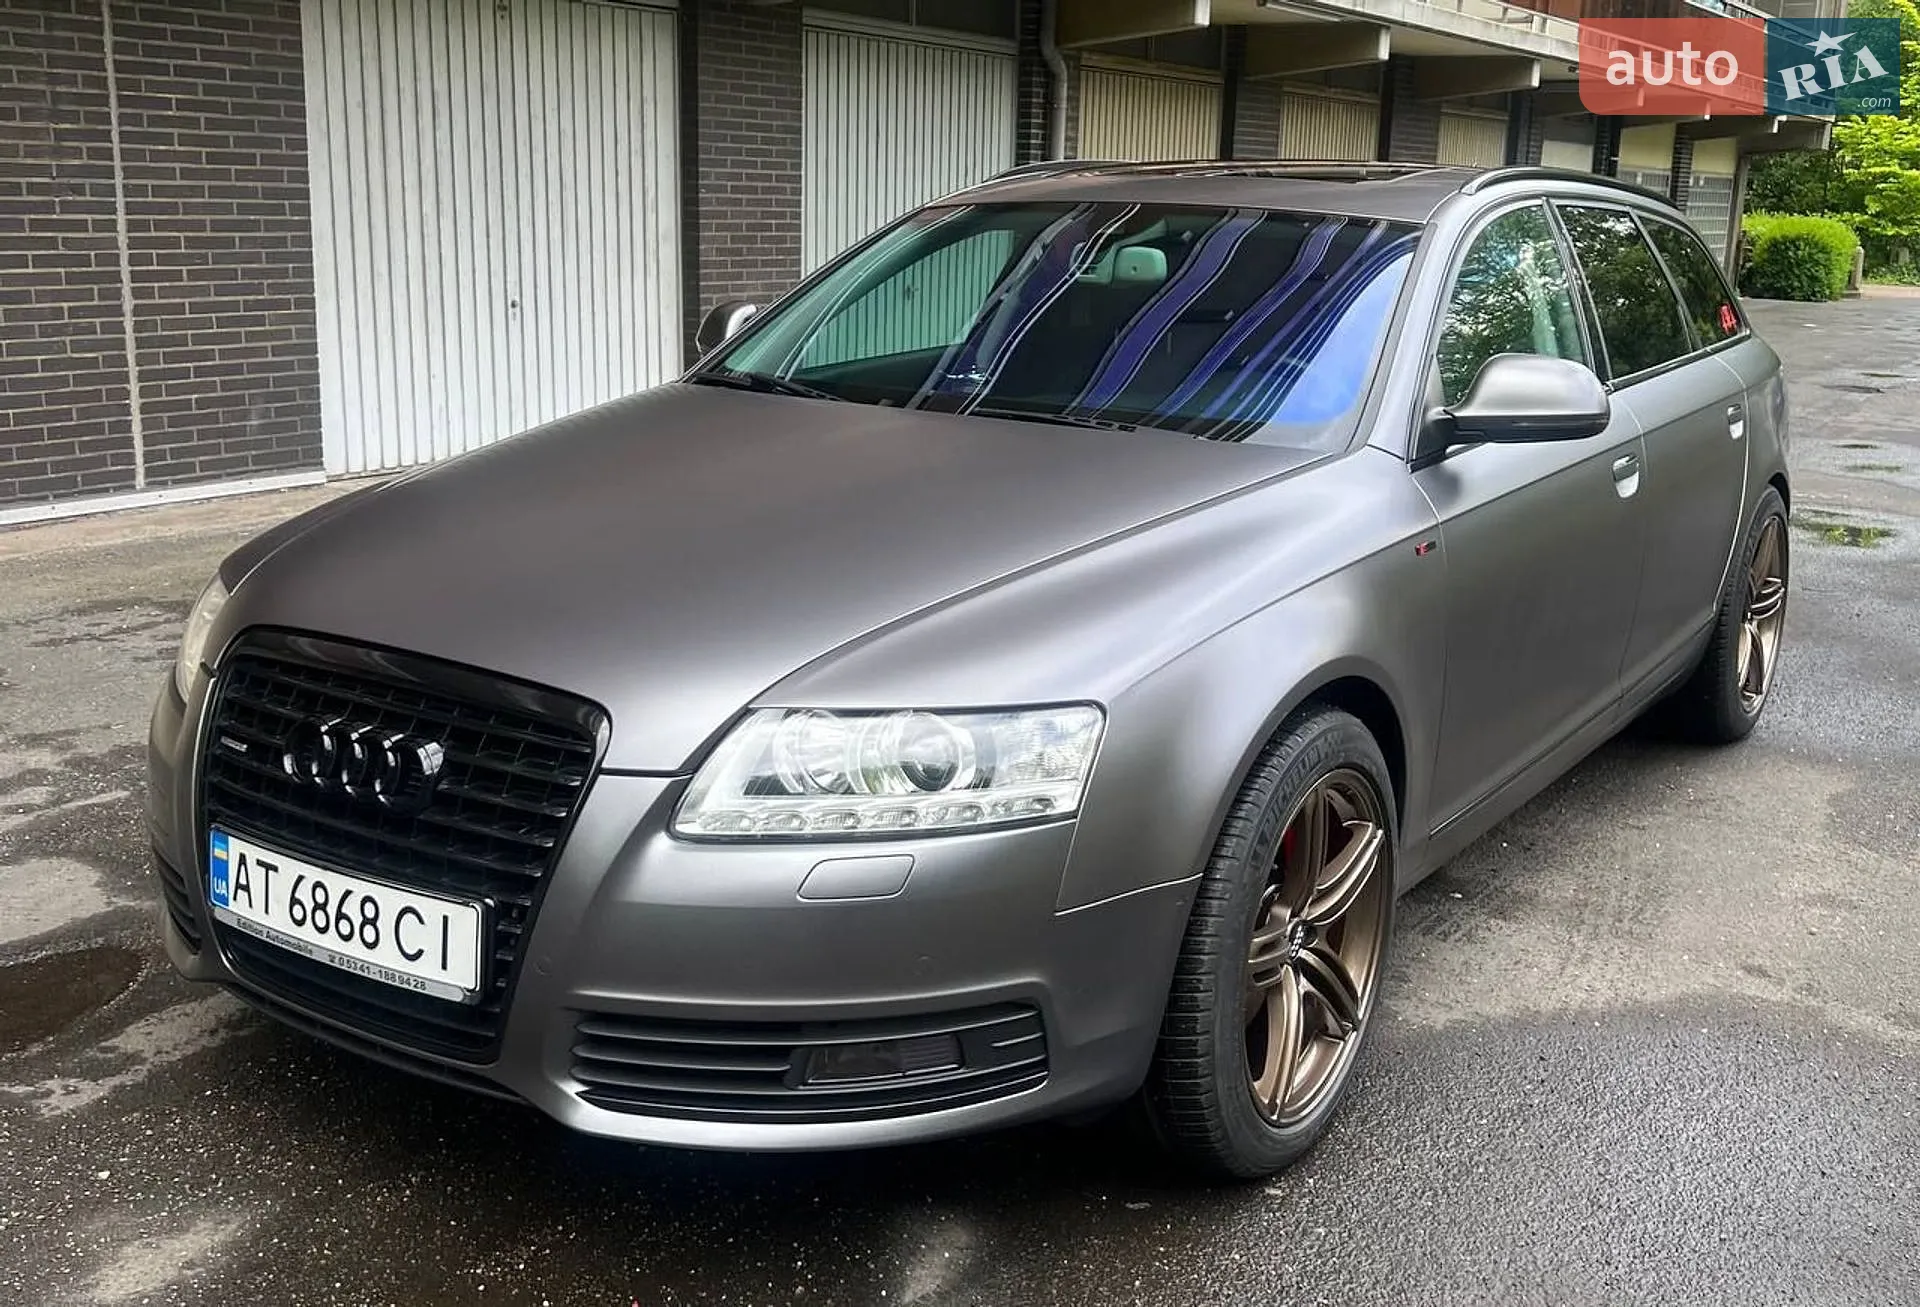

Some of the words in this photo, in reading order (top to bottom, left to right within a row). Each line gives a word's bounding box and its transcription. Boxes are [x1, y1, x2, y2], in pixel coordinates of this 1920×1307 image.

[214, 876, 229, 897] UA
[233, 852, 279, 915] AT
[288, 874, 380, 950] 6868
[394, 905, 449, 971] CI
